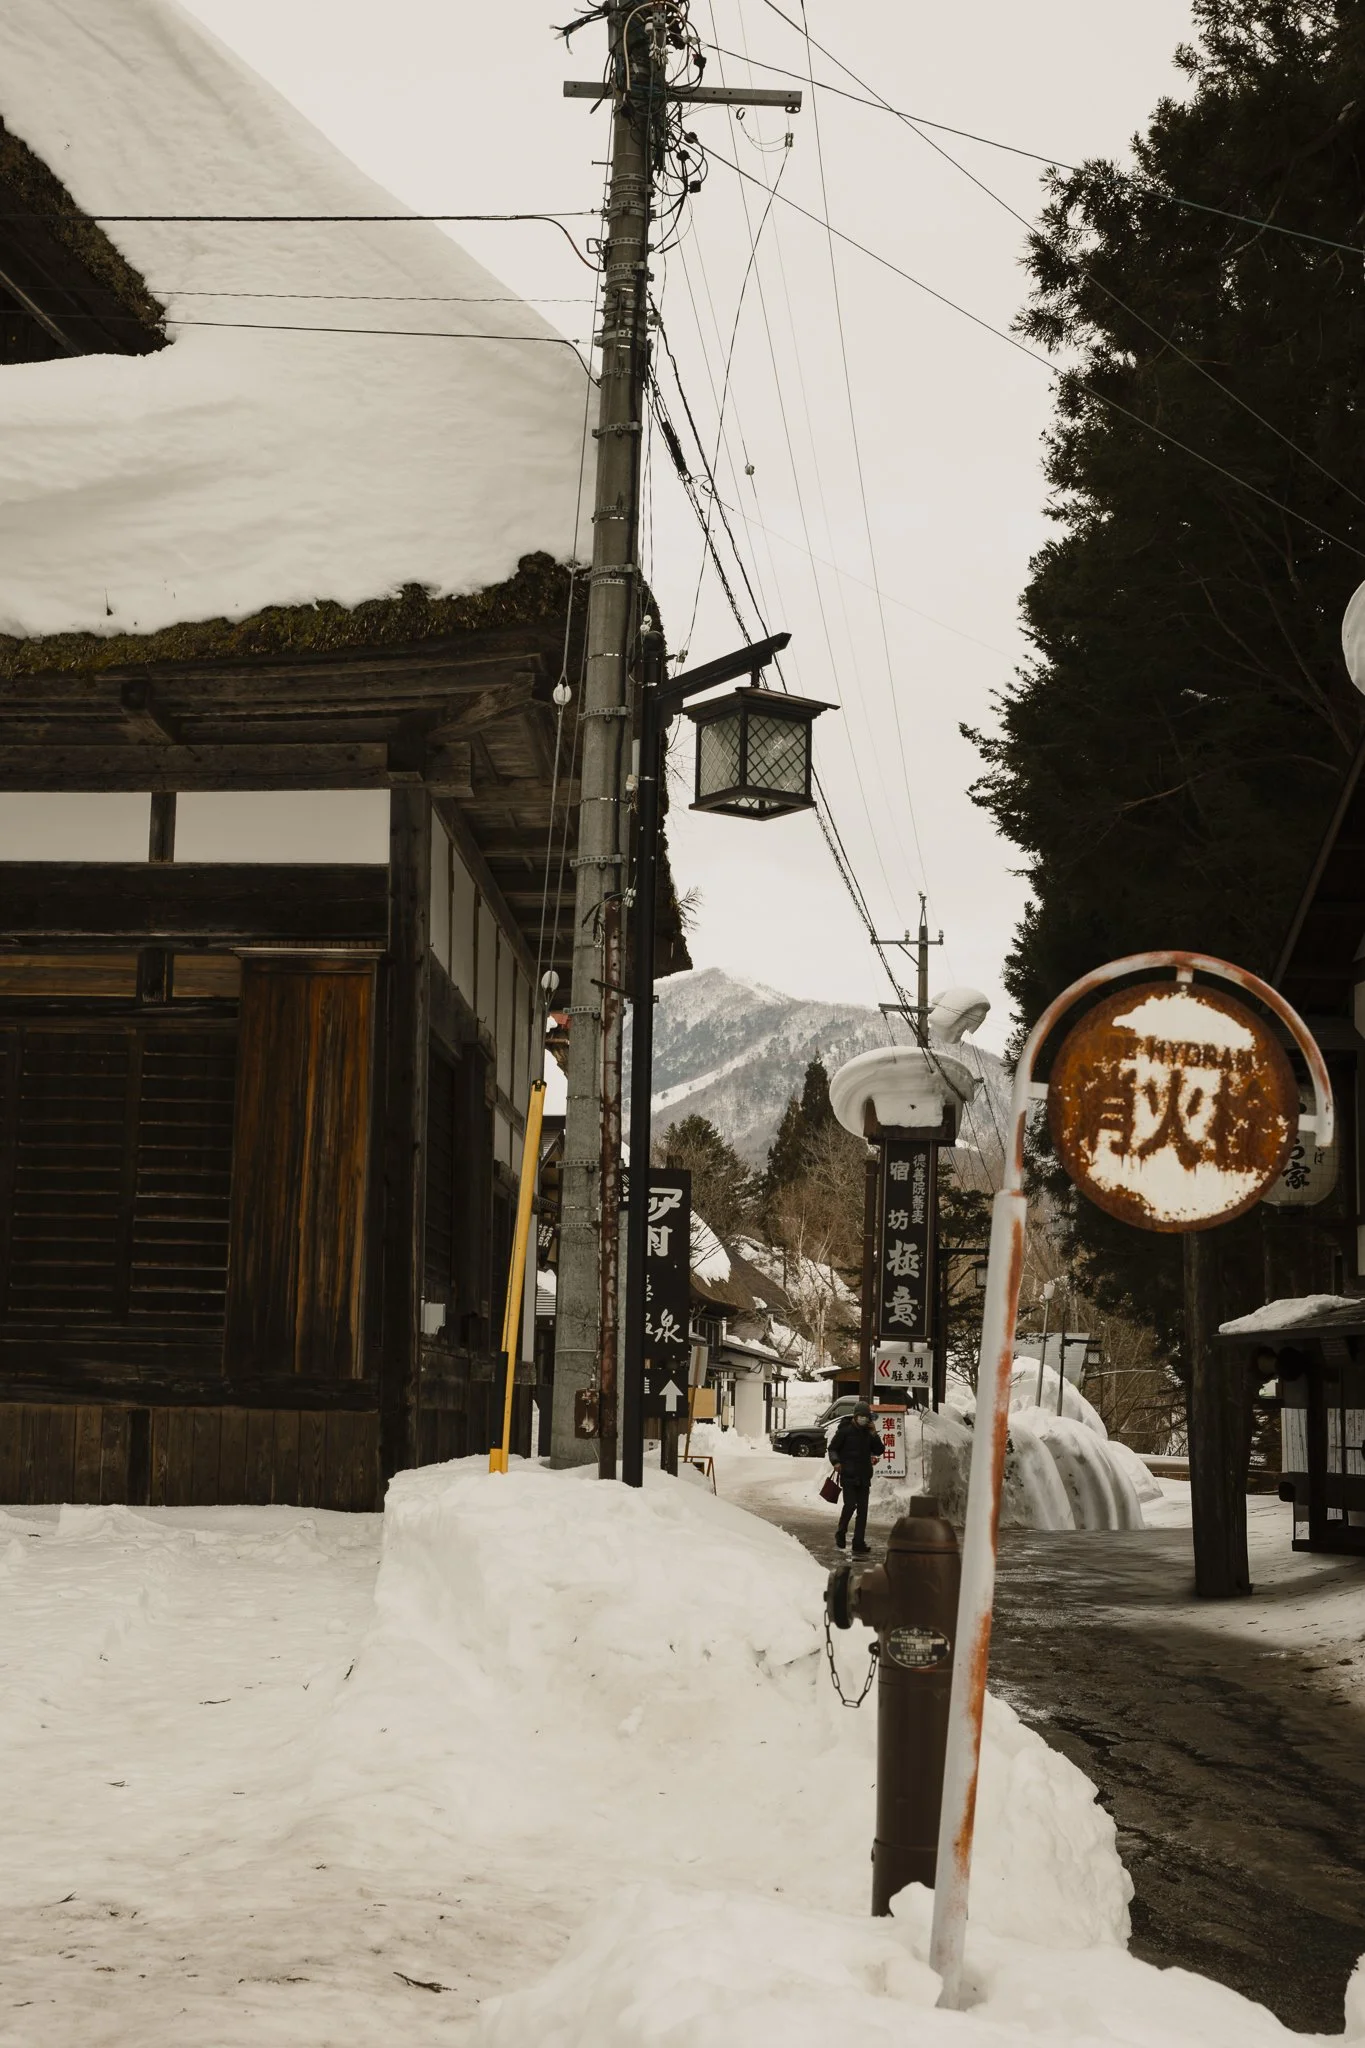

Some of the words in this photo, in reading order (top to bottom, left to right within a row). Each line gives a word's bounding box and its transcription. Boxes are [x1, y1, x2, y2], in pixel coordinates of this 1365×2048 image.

[898, 1356, 924, 1368] 専用
[891, 1370, 929, 1384] 駐車場
[882, 1417, 896, 1463] 準備中
